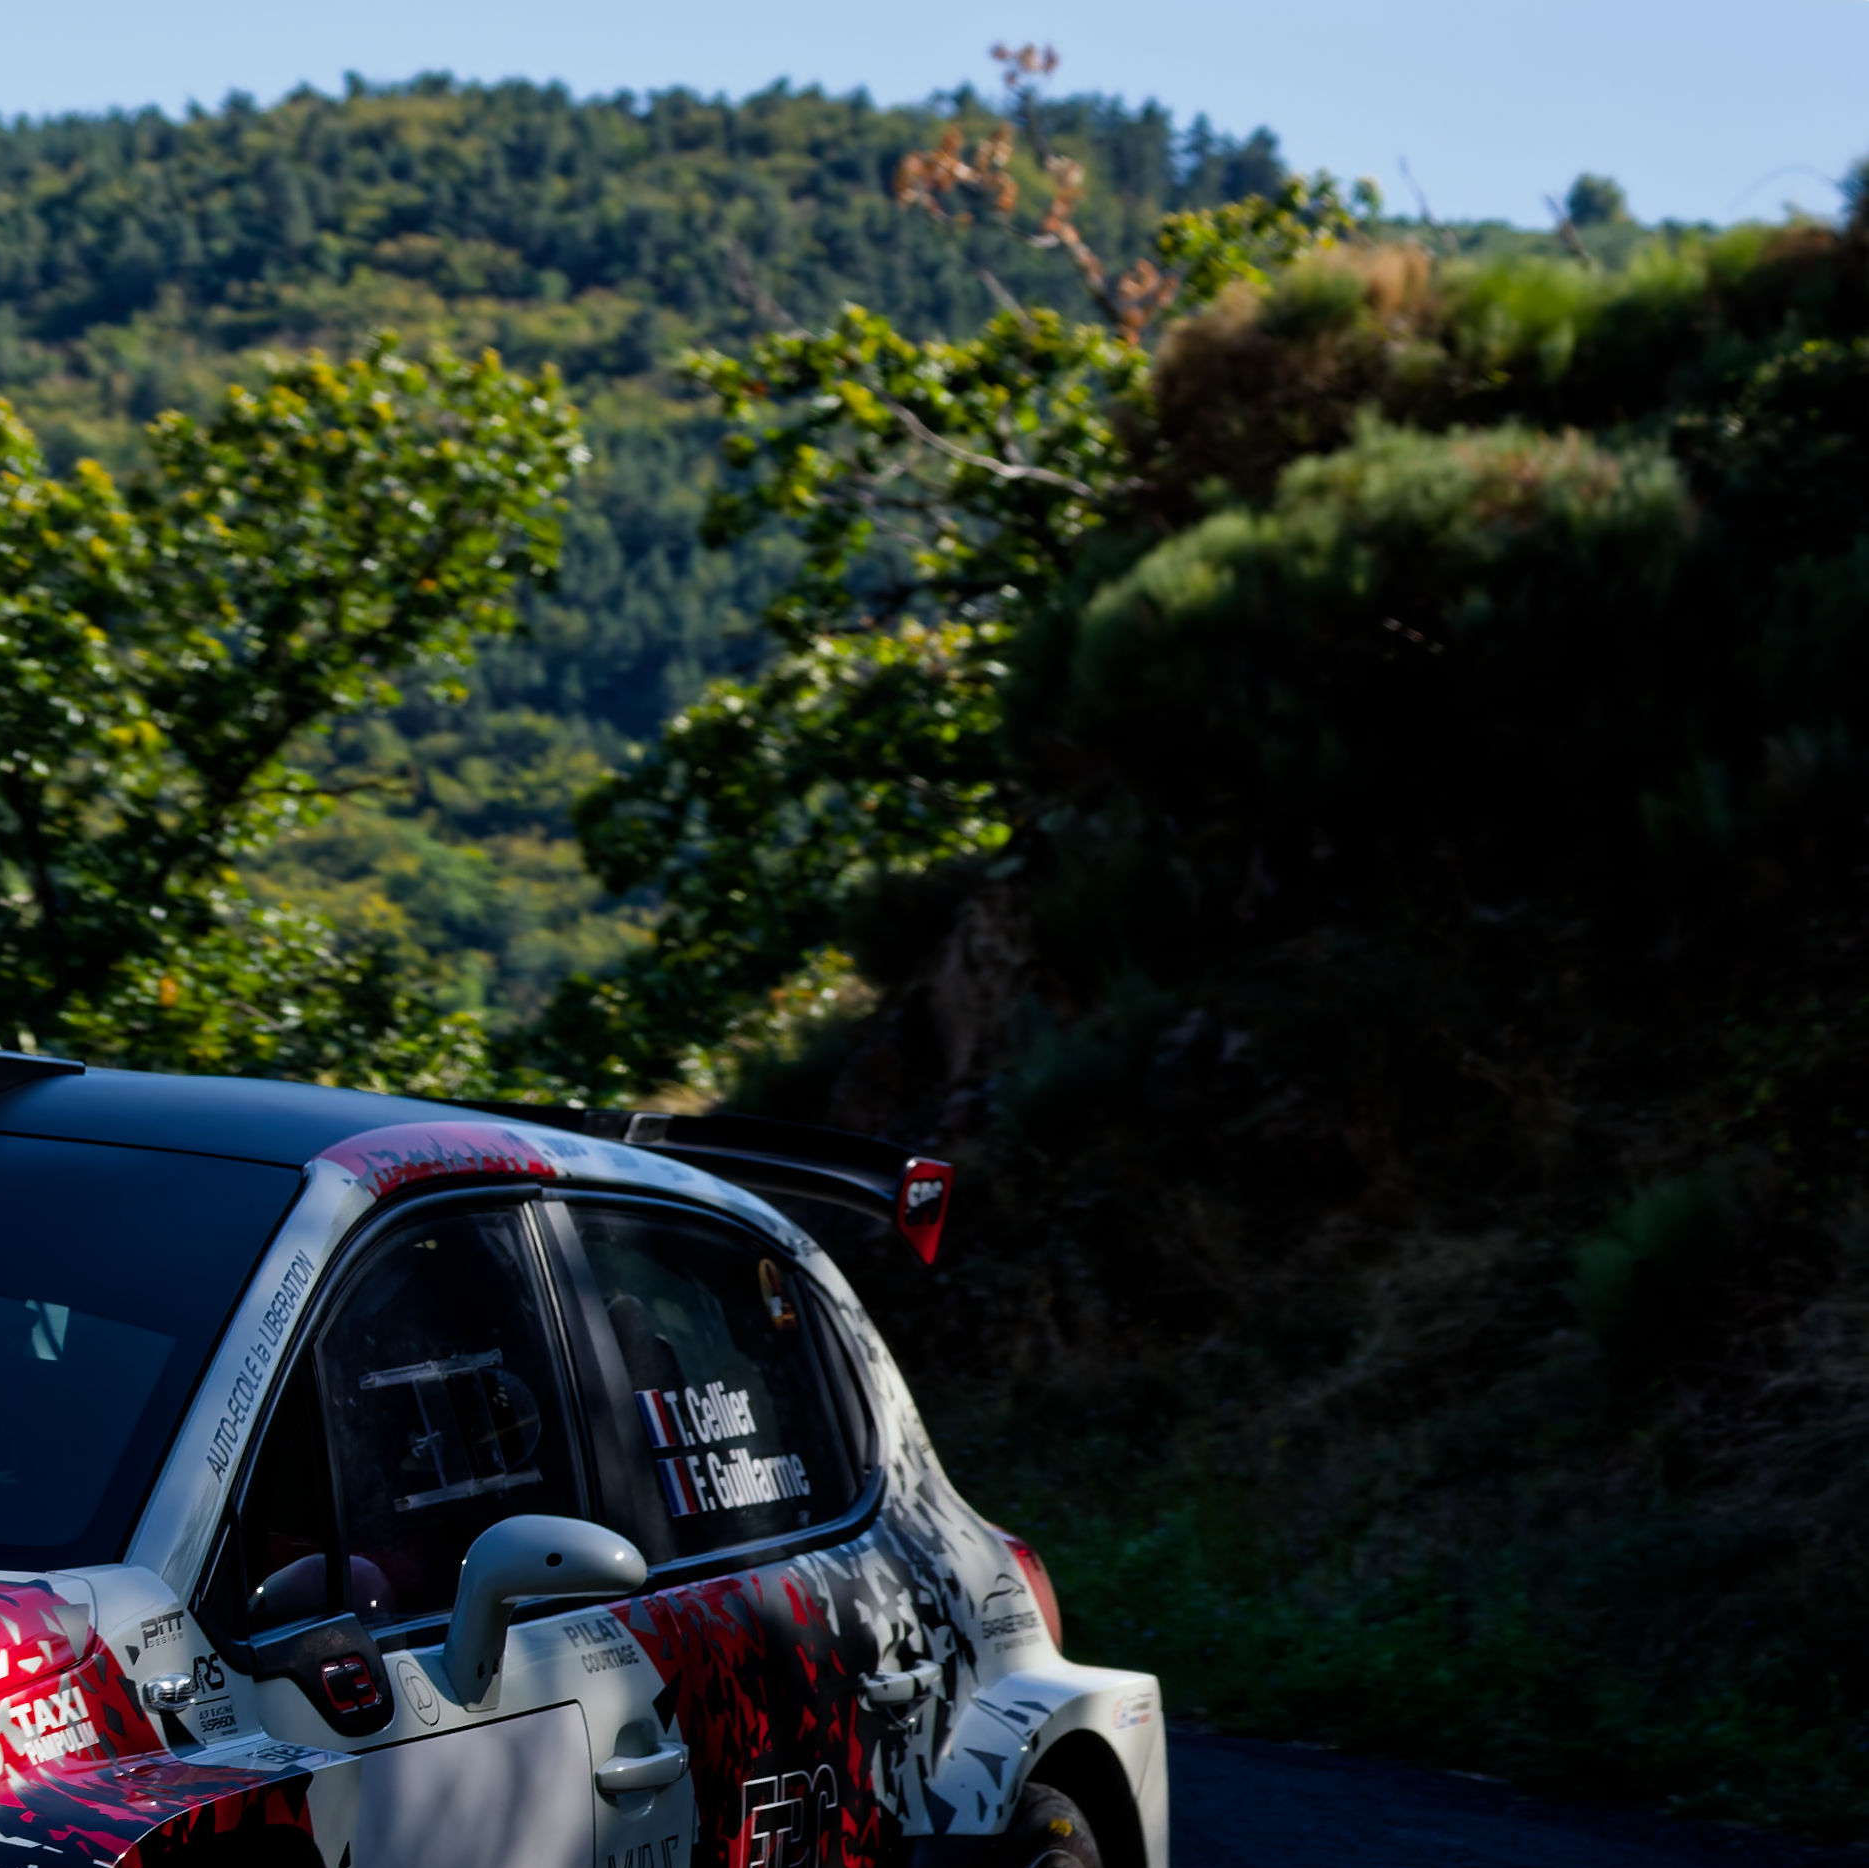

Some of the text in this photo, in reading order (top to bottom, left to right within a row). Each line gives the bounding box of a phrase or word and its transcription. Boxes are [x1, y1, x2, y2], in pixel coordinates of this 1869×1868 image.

[206, 1356, 264, 1484] AUTO-ECOLE
[259, 1249, 316, 1349] LIBERATION
[684, 1380, 757, 1444] Cellier
[562, 1616, 624, 1649] PILAT
[8, 1686, 89, 1737] TAXI
